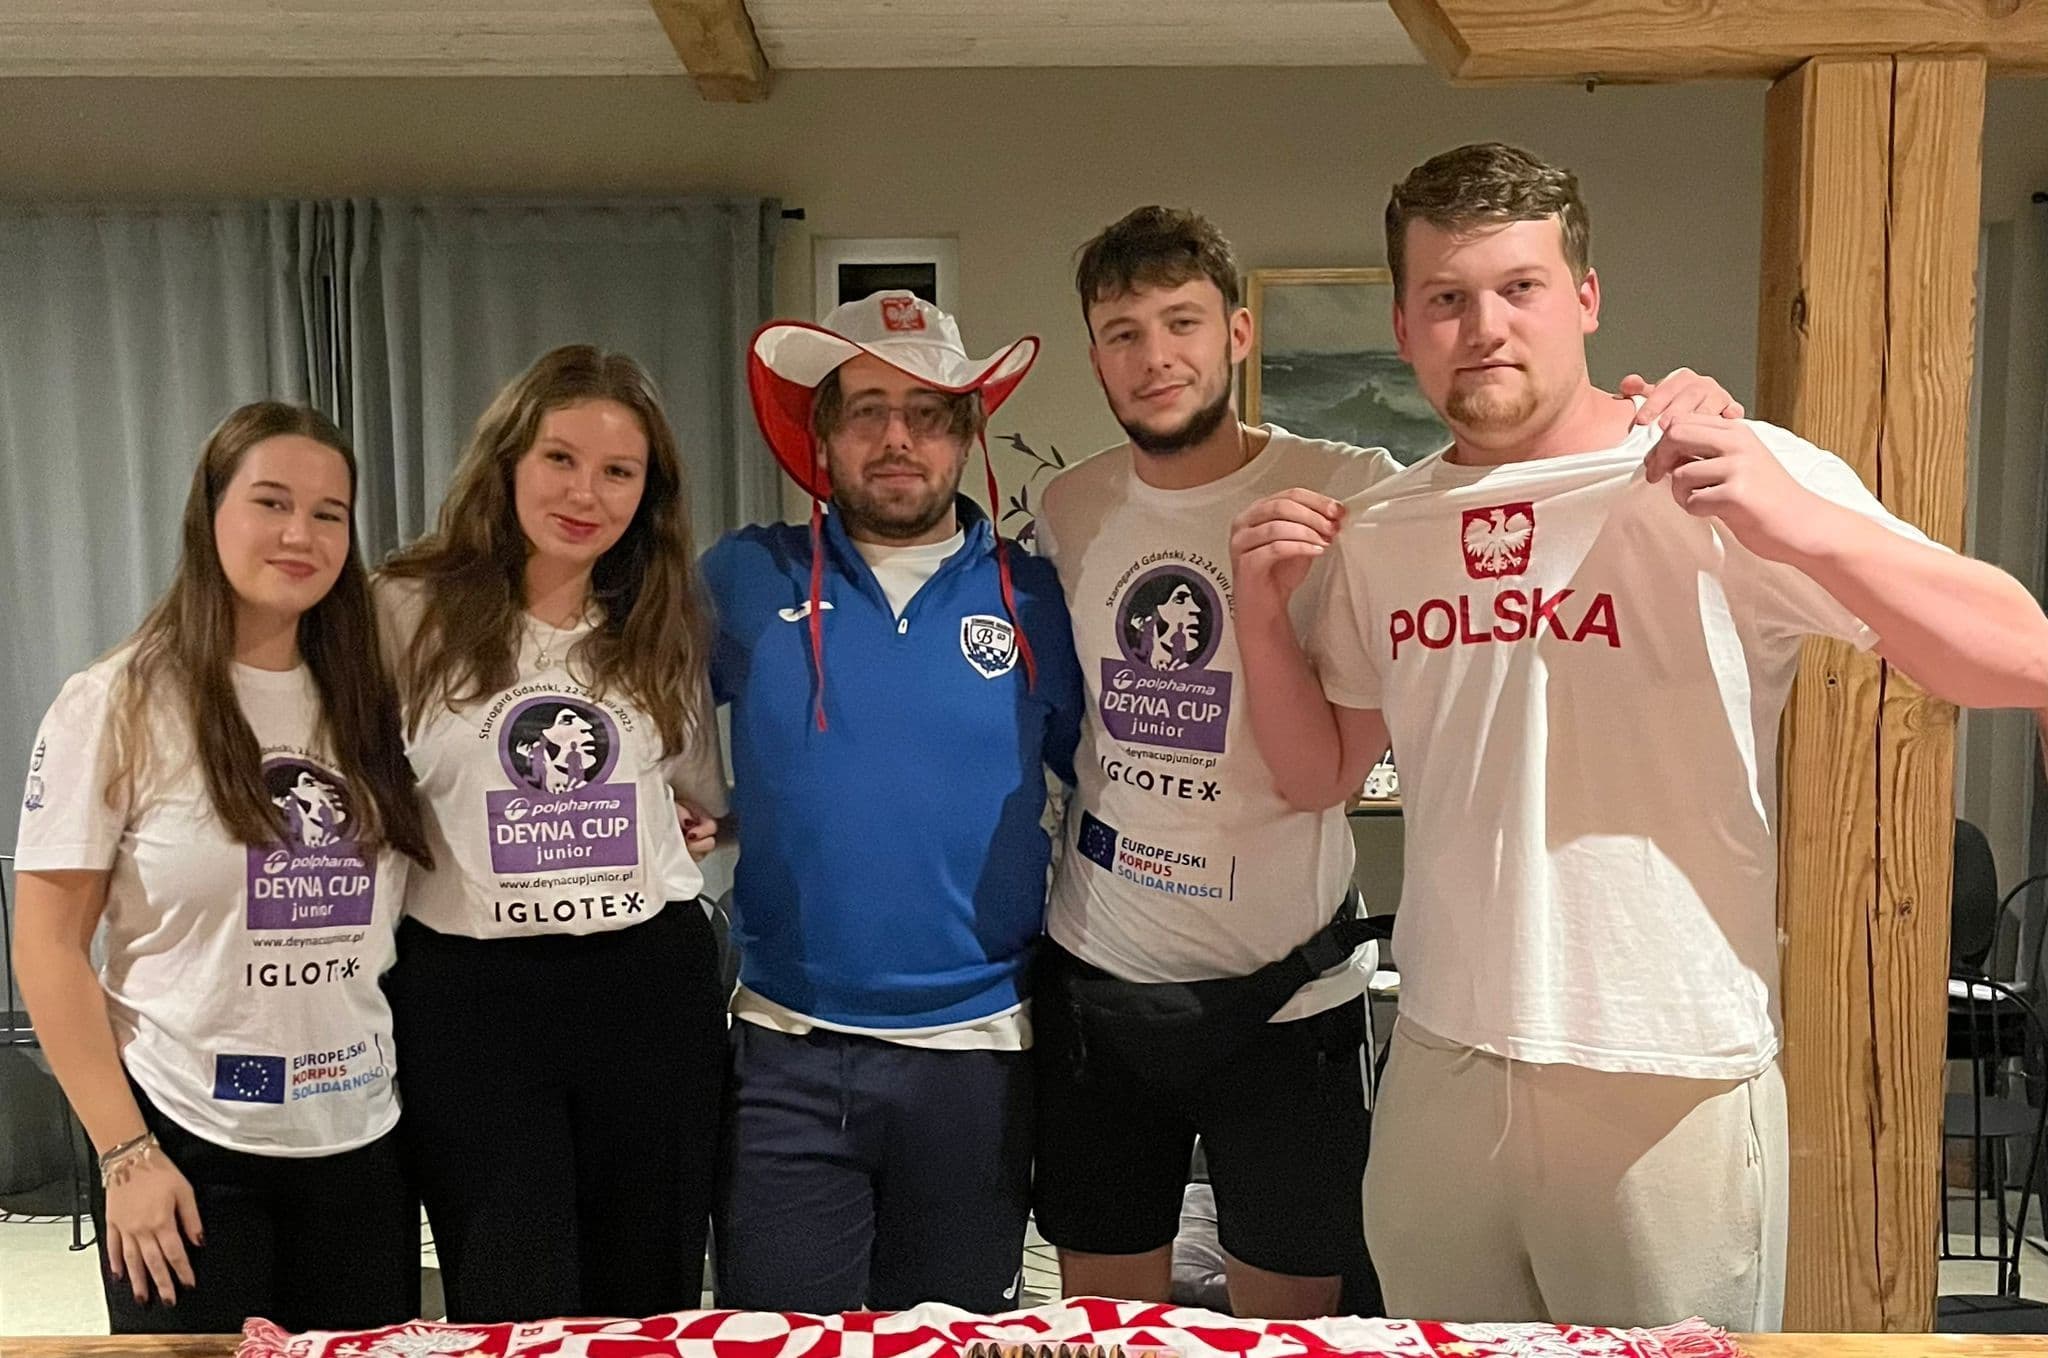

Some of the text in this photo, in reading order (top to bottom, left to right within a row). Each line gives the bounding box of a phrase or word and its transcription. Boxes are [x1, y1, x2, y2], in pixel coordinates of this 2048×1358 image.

[1106, 561, 1141, 608] Starogard
[1141, 549, 1187, 566] Gdański,
[1188, 553, 1218, 575] 22-24
[1216, 572, 1231, 591] VIII
[1391, 587, 1622, 660] POLSKA
[1135, 678, 1216, 696] polpharma
[479, 693, 513, 740] Starogard
[1104, 690, 1222, 723] DEYNA CUP
[1131, 717, 1184, 738] junior
[531, 799, 621, 816] polpharma
[496, 817, 629, 845] DEYNA CUP
[536, 844, 593, 865] junior
[1119, 851, 1172, 877] KORPUS
[1121, 837, 1206, 868] EUROPEJSKI
[255, 875, 370, 899] DEYNA CUP
[499, 871, 633, 889] www.deynacupjunior.pl
[1118, 865, 1223, 899] SOLIDARNOŚCI
[494, 892, 645, 924] IGLOTEX
[246, 957, 360, 987] IGLOTX
[292, 1064, 348, 1086] KORPUS
